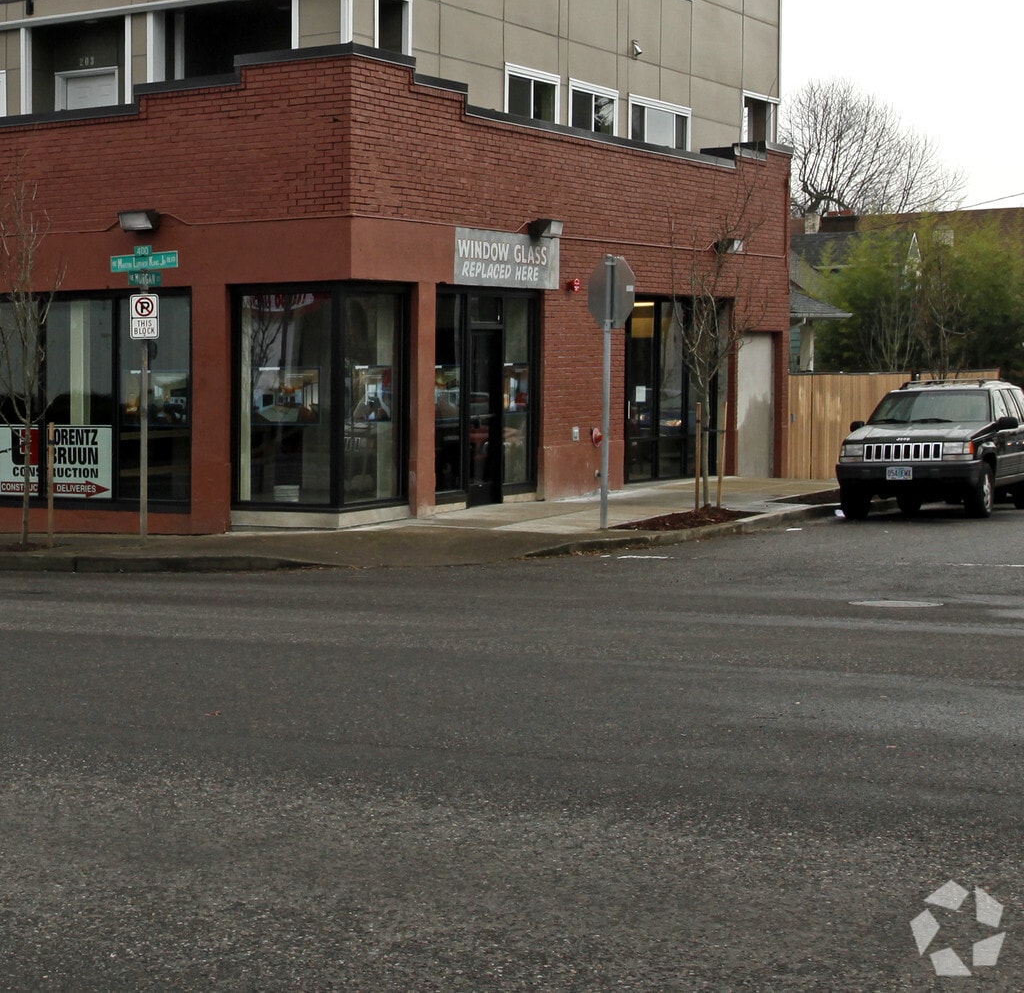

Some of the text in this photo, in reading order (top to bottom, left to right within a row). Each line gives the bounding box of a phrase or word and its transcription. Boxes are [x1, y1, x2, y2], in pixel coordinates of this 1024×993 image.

[137, 246, 148, 255] 400
[458, 239, 547, 266] WINDOW GLASS
[462, 261, 539, 282] REPLACED HERE
[137, 319, 153, 327] THIS
[48, 429, 98, 446] ORENTZ
[56, 484, 97, 494] DELIVERIES
